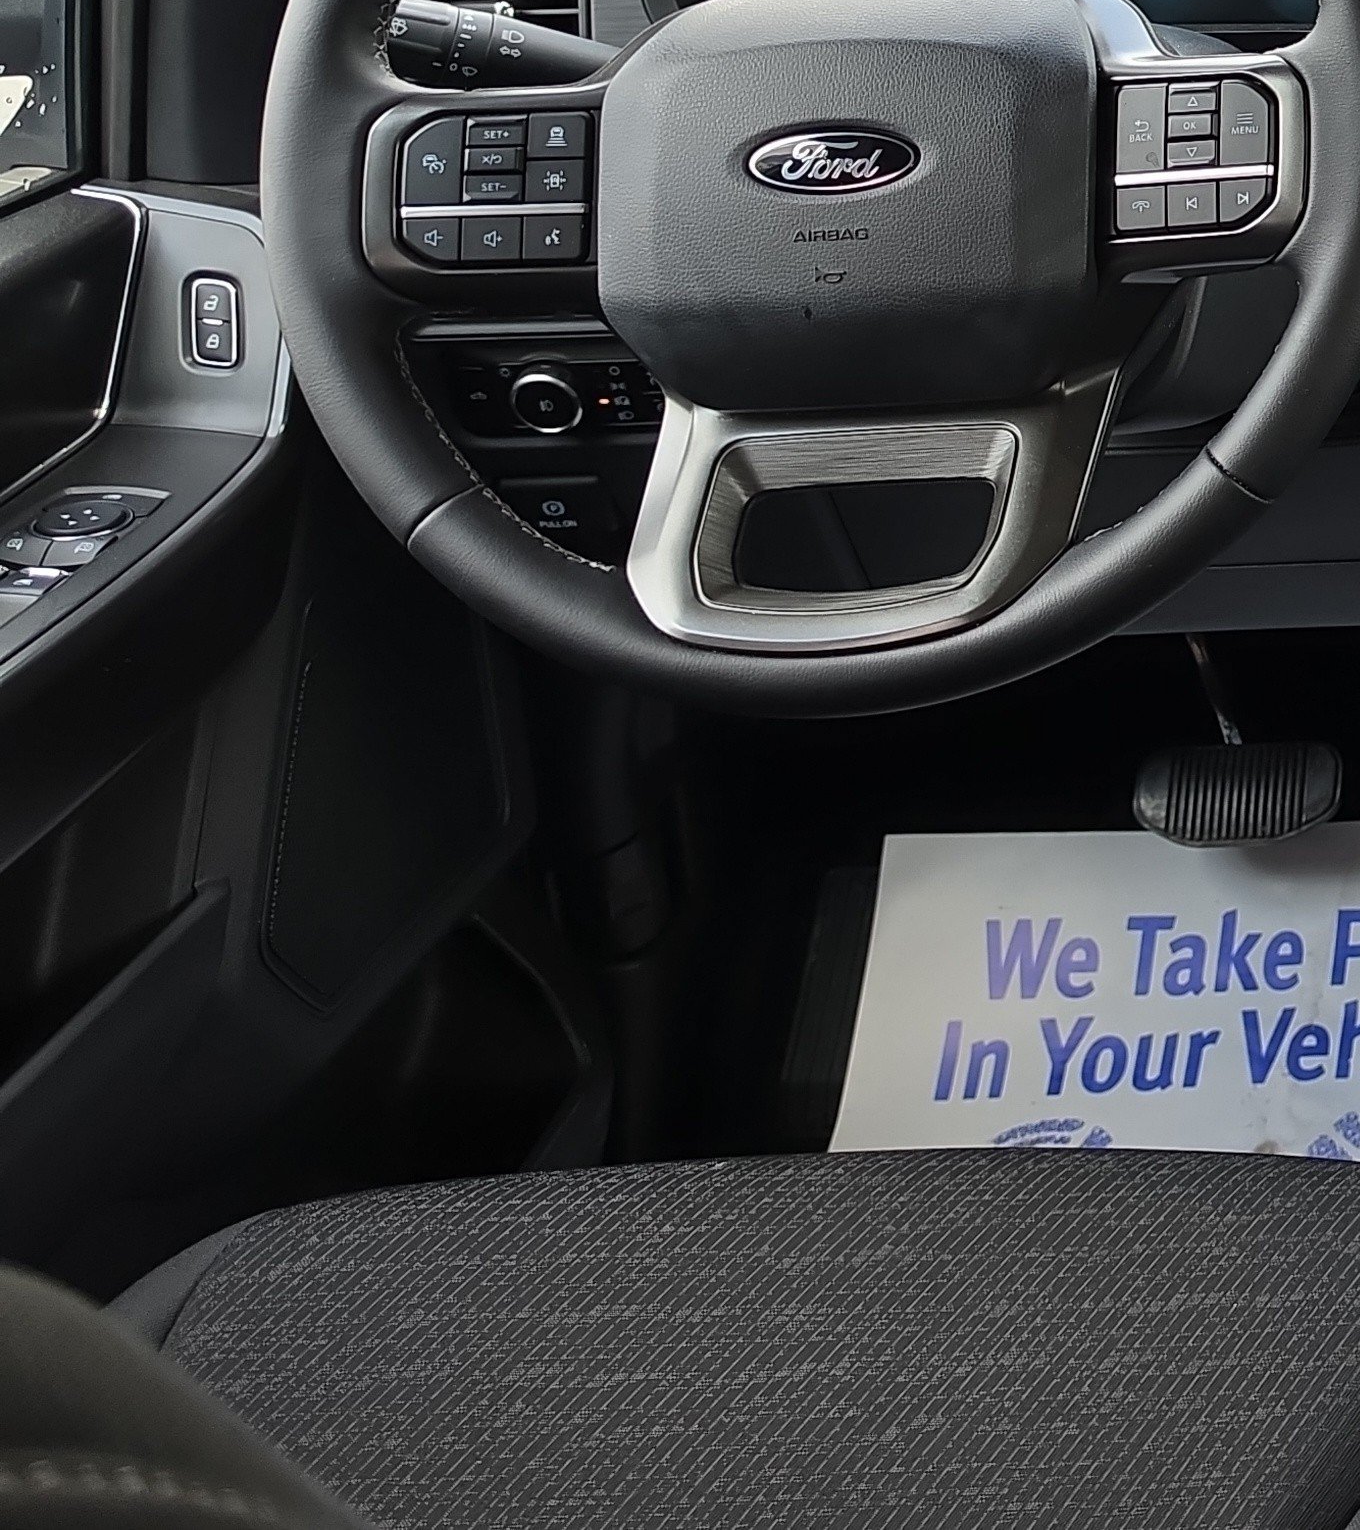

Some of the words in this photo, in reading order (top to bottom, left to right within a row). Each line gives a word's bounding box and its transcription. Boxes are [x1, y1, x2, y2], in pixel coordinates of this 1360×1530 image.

[1183, 121, 1197, 130] OK
[1230, 125, 1259, 135] MENU
[1129, 134, 1154, 143] BACK
[781, 140, 884, 181] Ford
[792, 228, 870, 243] AIRBAG
[985, 917, 1101, 1000] We
[1126, 909, 1304, 997] Take
[932, 1018, 1012, 1102] In
[1040, 1015, 1220, 1097] Your
